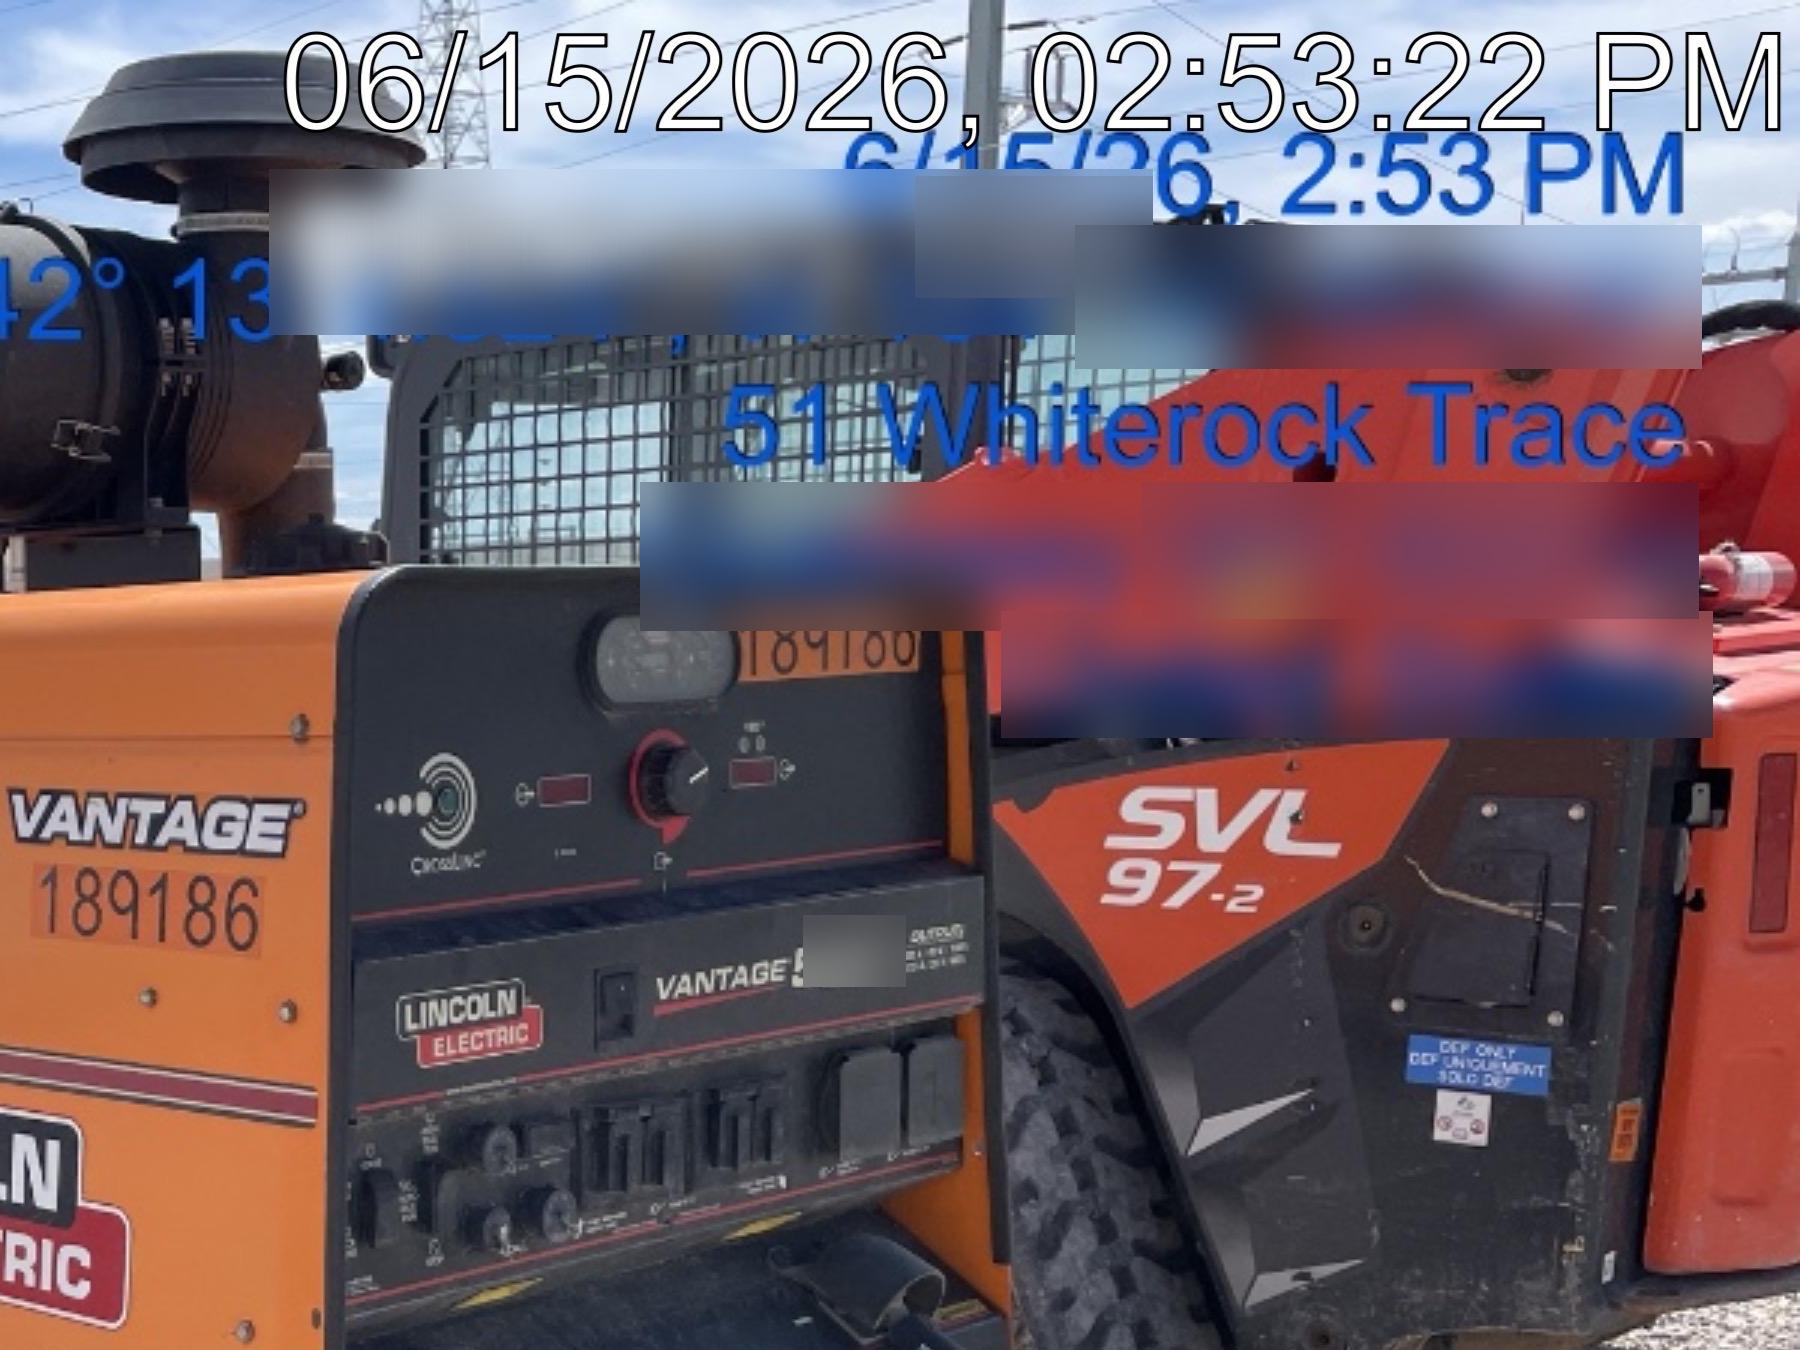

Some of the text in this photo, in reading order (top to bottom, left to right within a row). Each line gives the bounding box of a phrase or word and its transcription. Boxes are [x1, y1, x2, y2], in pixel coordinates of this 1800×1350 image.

[7, 789, 295, 858] VANTAGE
[1102, 785, 1343, 858] SVL
[40, 864, 260, 952] 189186
[1099, 857, 1265, 913] 97-2
[655, 958, 792, 1001] VANTAGE
[404, 988, 518, 1031] LINCOLN
[433, 1022, 530, 1058] ELECTRIC
